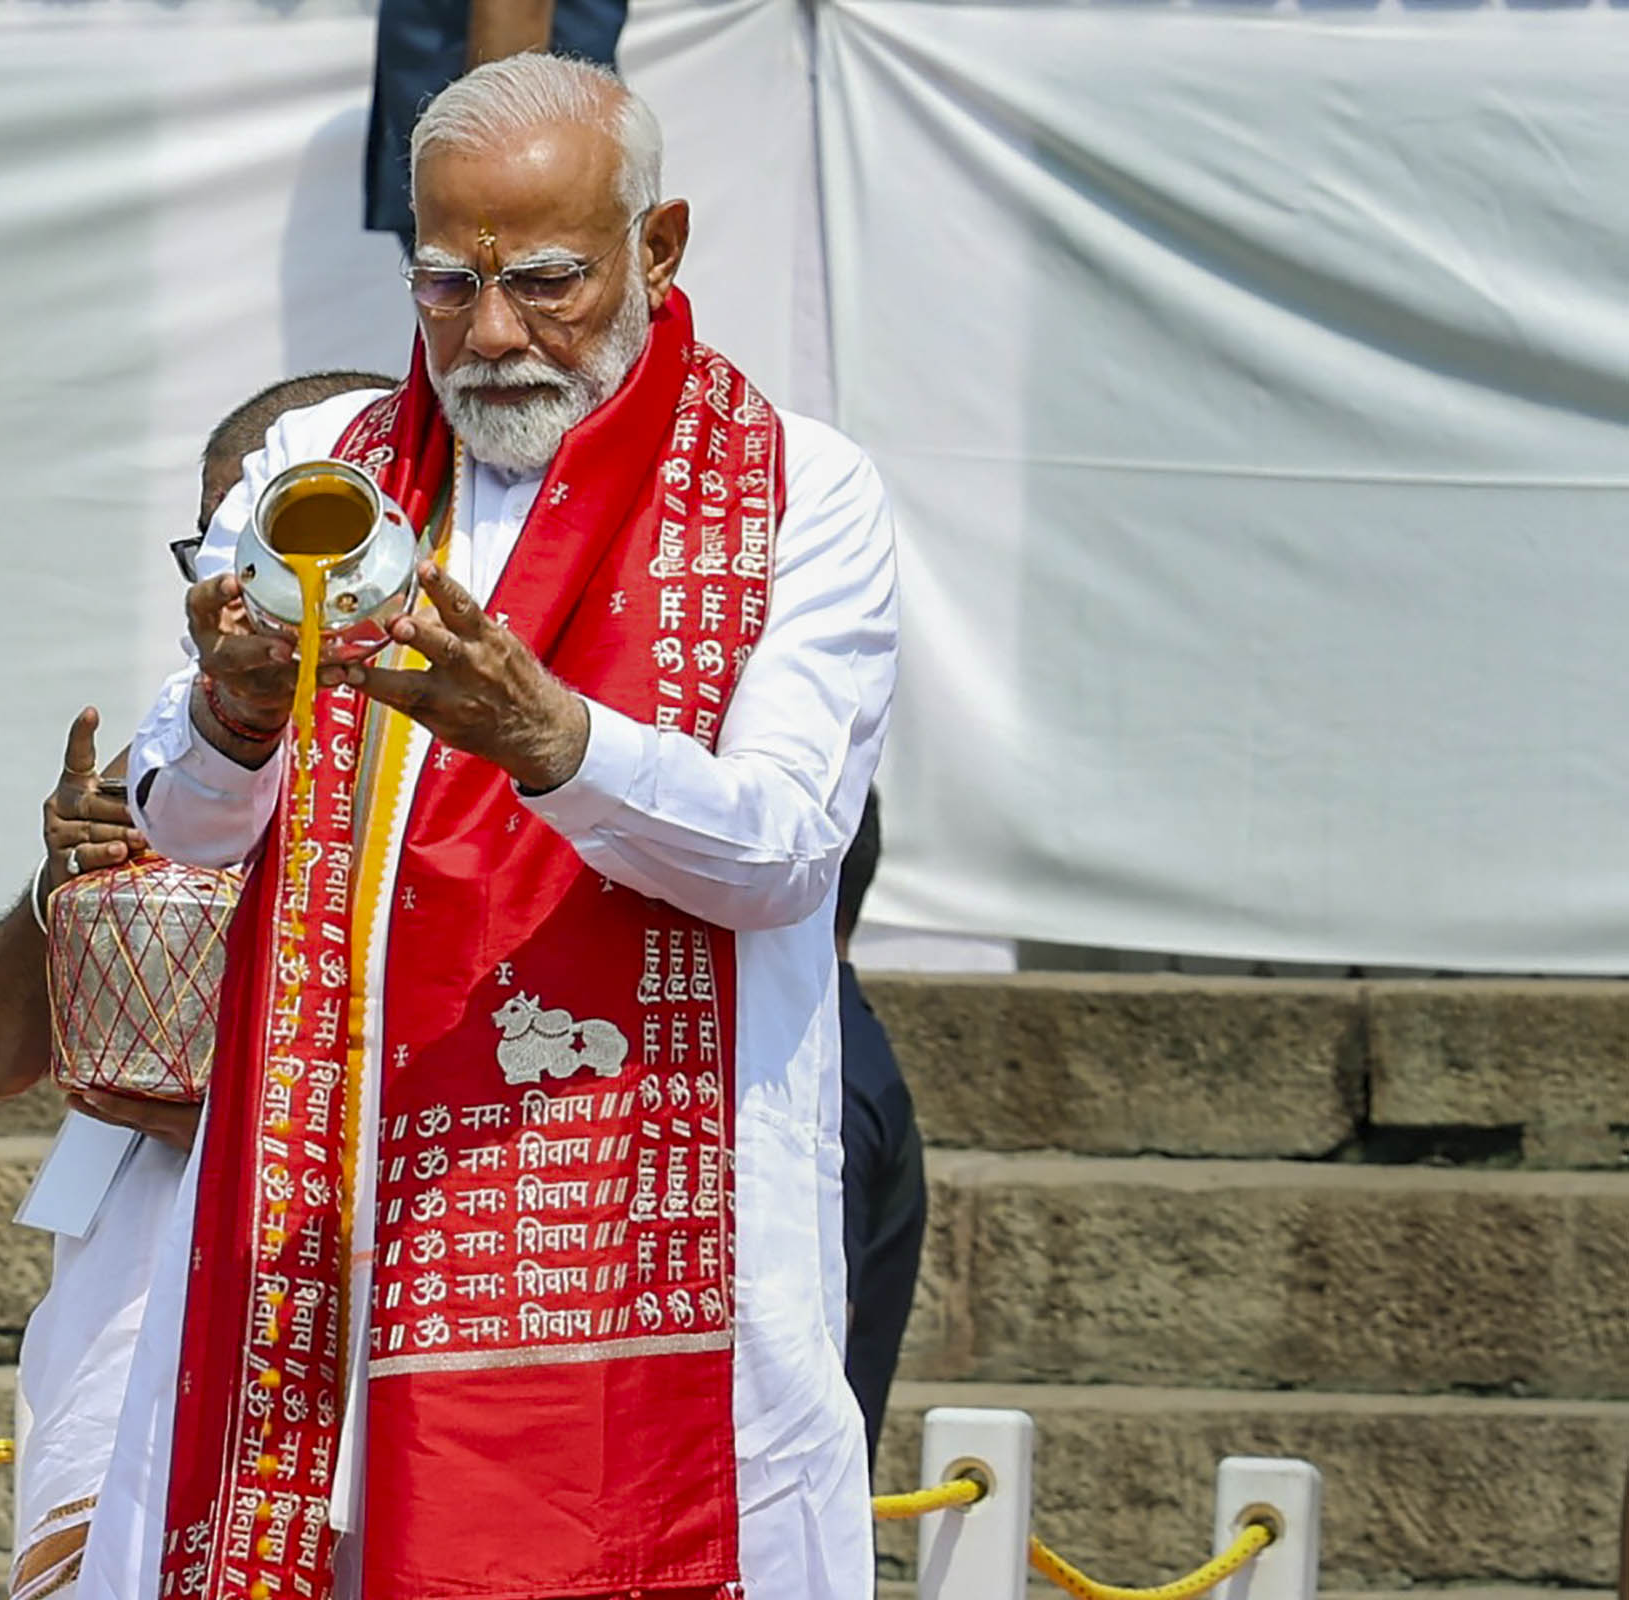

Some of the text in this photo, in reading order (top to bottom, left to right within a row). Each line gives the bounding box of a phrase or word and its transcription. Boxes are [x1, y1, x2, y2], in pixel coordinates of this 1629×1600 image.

[671, 412, 699, 451] नमः
[707, 425, 727, 463] नमः
[744, 431, 767, 464] नमः
[660, 458, 690, 490] ॐ
[699, 470, 728, 501] ॐ
[735, 469, 769, 495] ॐ
[649, 518, 686, 580] शिवाय
[691, 524, 727, 577] शिवाय
[732, 513, 770, 583] शिवाय
[660, 585, 686, 630] नमः
[700, 584, 726, 632] नमः
[741, 588, 767, 639] नमः
[652, 637, 684, 673] ॐ
[692, 640, 724, 676] ॐ
[278, 950, 310, 985] ॐ
[319, 950, 347, 987] ॐ
[637, 930, 661, 1005] शिवाय
[664, 930, 688, 1003] शिवाय
[690, 933, 716, 1004] शिवाय
[273, 995, 303, 1046] नमः
[313, 998, 340, 1048] नमः
[644, 1015, 660, 1064] नमः
[671, 1013, 688, 1062] नमः
[699, 1009, 717, 1061] नमः
[264, 1054, 305, 1127] शिवाय
[306, 1059, 343, 1138] शिवाय
[417, 1104, 451, 1137] ॐ
[461, 1104, 510, 1130] नमः
[520, 1090, 594, 1125] शिवाय
[639, 1074, 662, 1112] ॐ
[667, 1073, 690, 1110] ॐ
[695, 1068, 721, 1112] ॐ
[414, 1146, 448, 1179] ॐ
[458, 1146, 507, 1173] नमः
[516, 1131, 591, 1169] शिवाय
[260, 1160, 294, 1204] ॐ
[302, 1169, 330, 1206] ॐ
[411, 1187, 446, 1221] ॐ
[456, 1189, 506, 1216] नमः
[514, 1174, 589, 1212] शिवाय
[629, 1148, 657, 1222] शिवाय
[661, 1146, 688, 1221] शिवाय
[692, 1144, 718, 1219] शिवाय
[299, 1216, 322, 1266] नमः
[410, 1229, 446, 1264] ॐ
[454, 1231, 505, 1258] नमः
[514, 1217, 588, 1254] शिवाय
[638, 1232, 657, 1282] नमः
[668, 1230, 687, 1280] नमः
[699, 1230, 718, 1278] नमः
[411, 1271, 446, 1305] ॐ
[455, 1273, 505, 1300] नमः
[513, 1259, 587, 1296] शिवाय
[699, 1284, 726, 1324] ॐ
[289, 1278, 328, 1355] शिवाय
[413, 1313, 450, 1347] ॐ
[458, 1316, 509, 1342] नमः
[517, 1302, 591, 1340] शिवाय
[635, 1292, 662, 1330] ॐ
[667, 1289, 694, 1327] ॐ
[247, 1379, 275, 1418] ॐ
[283, 1385, 308, 1421] ॐ
[277, 1432, 301, 1480] नमः
[228, 1486, 266, 1561] शिवाय
[264, 1491, 304, 1565] शिवाय
[294, 1492, 334, 1569] शिवाय
